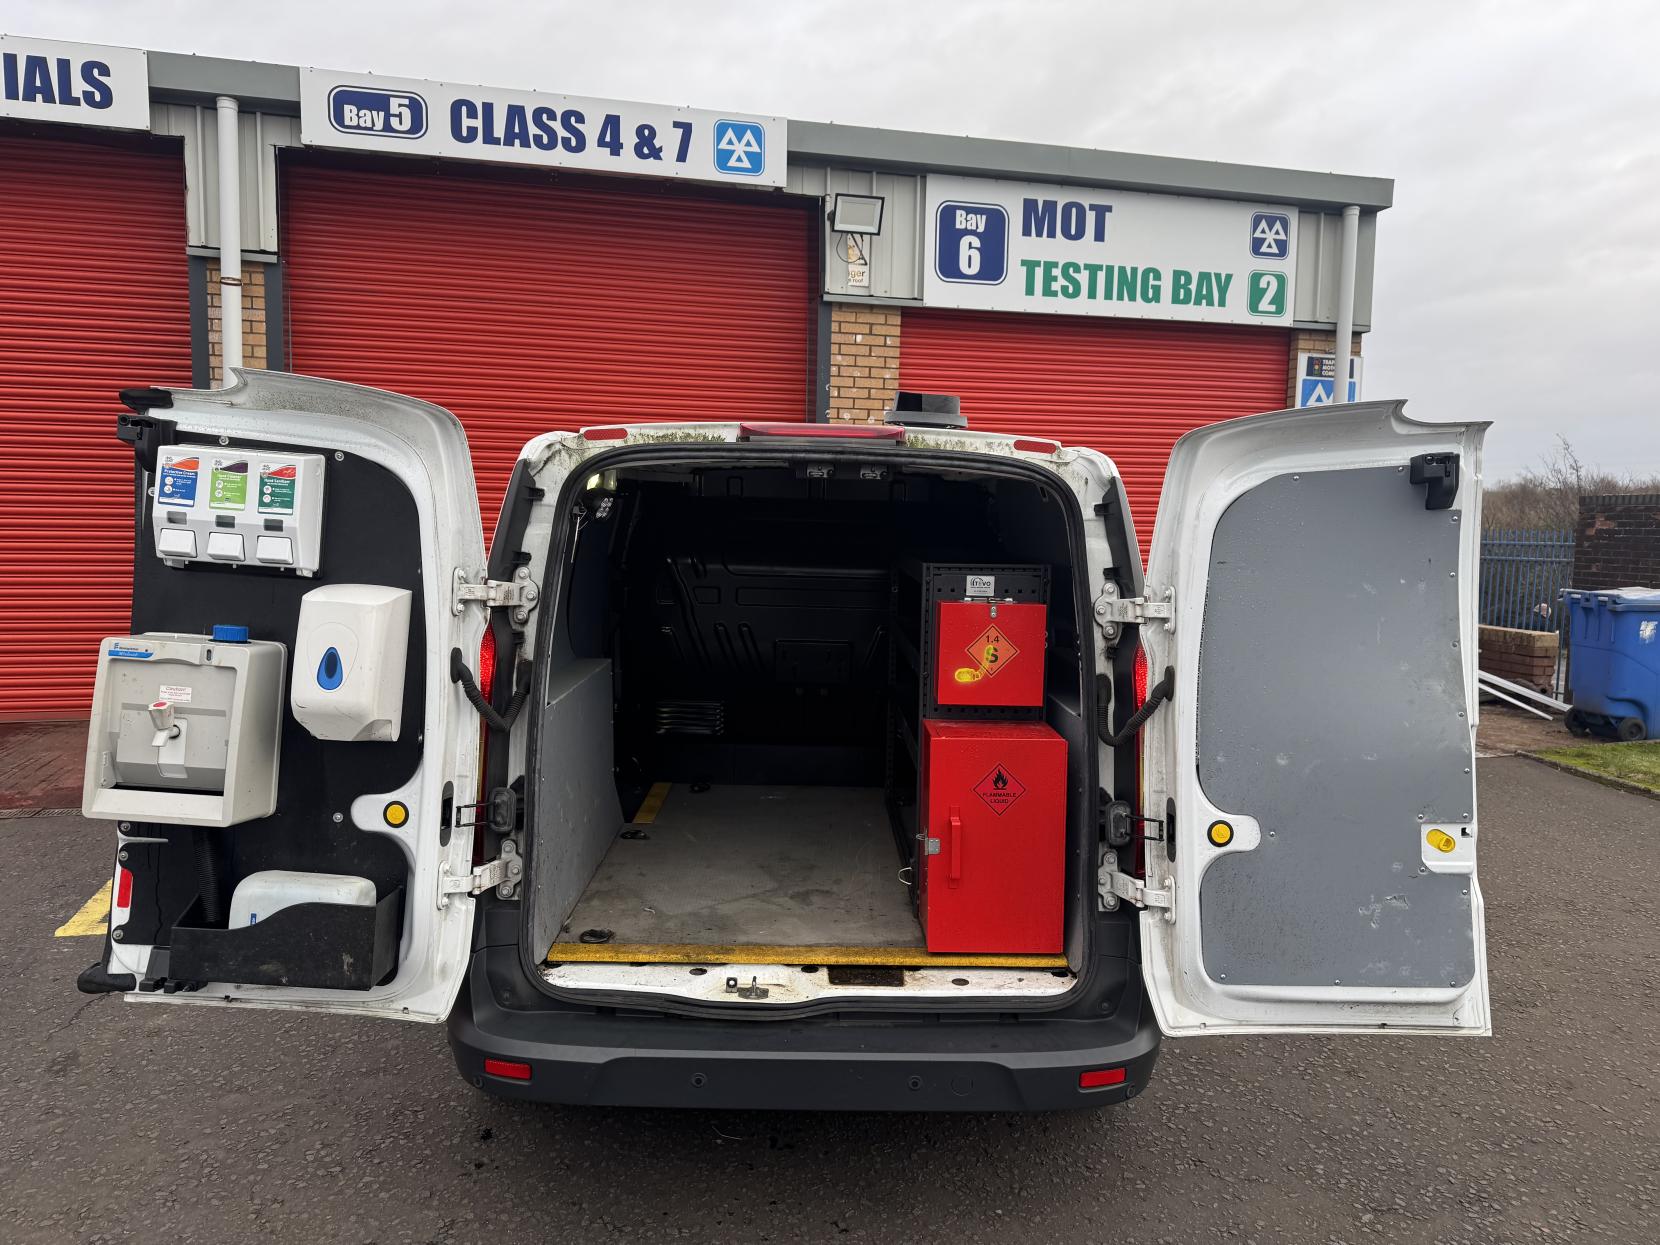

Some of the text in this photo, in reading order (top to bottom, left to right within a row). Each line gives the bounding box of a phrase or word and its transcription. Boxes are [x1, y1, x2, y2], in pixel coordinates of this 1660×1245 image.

[3, 52, 113, 109] IALS
[343, 97, 412, 131] Bay 5
[450, 98, 693, 163] CLASS 4 & 7
[955, 209, 987, 233] Bay
[1022, 198, 1113, 242] MOT
[959, 235, 981, 276] 6
[1020, 259, 1278, 312] TESTING BAY 2
[986, 635, 999, 643] 1.4
[986, 645, 999, 663] S
